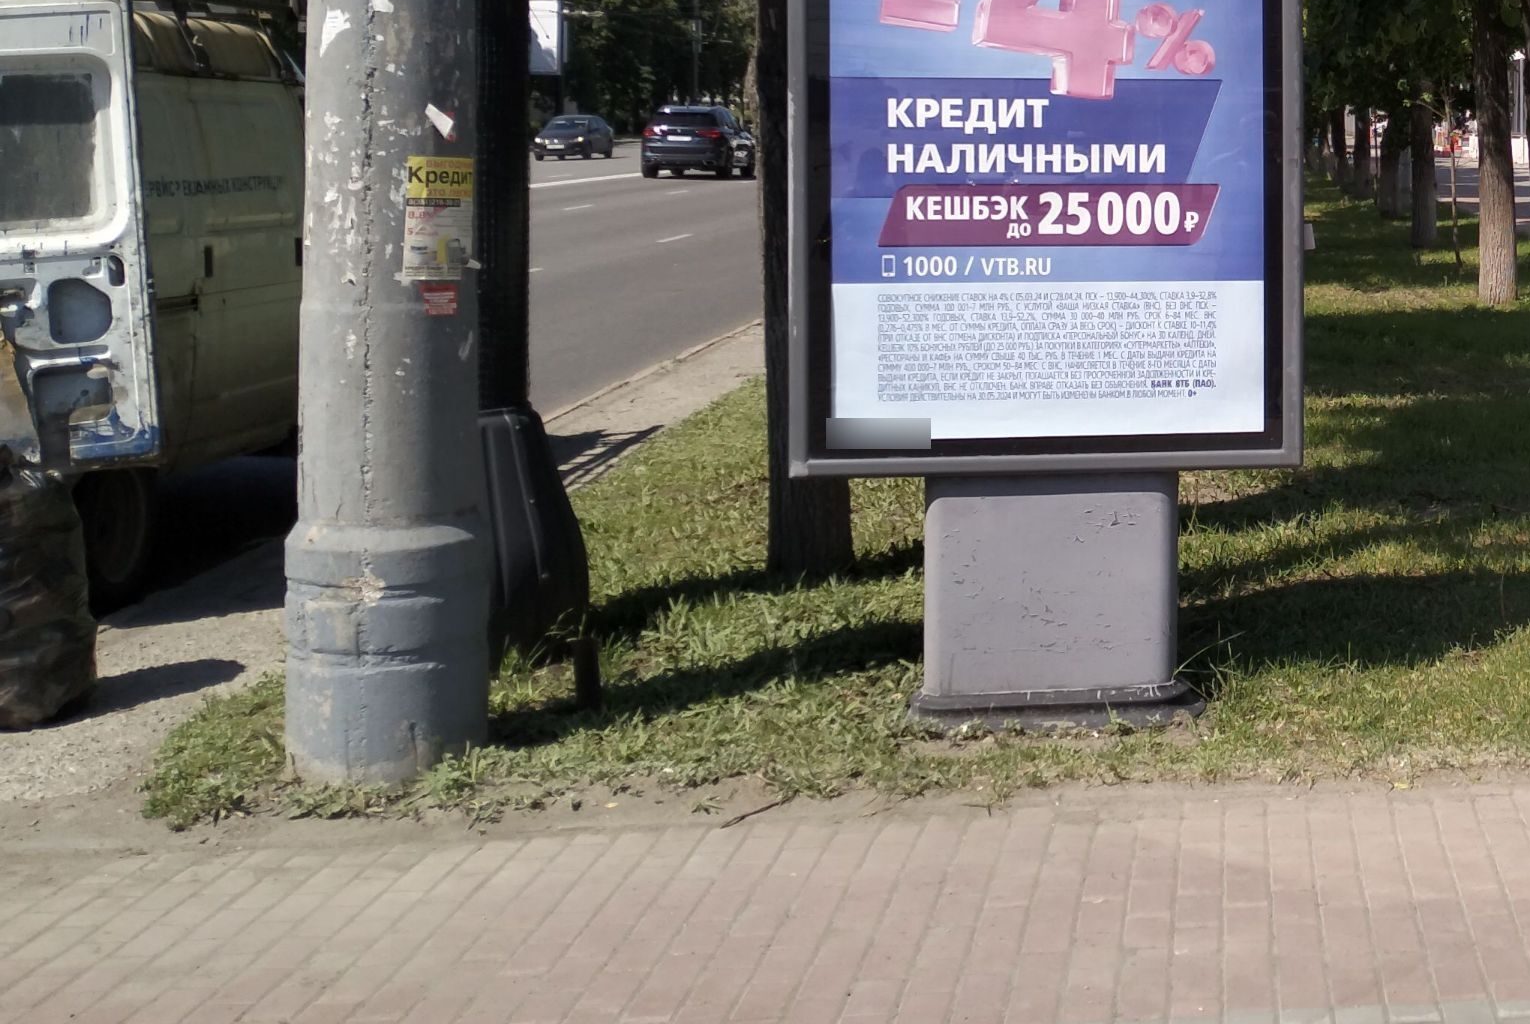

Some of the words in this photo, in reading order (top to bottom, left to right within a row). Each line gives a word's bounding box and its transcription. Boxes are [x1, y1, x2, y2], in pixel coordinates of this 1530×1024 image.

[887, 97, 1049, 134] КРЕДИТ
[887, 143, 1166, 174] НАЛИЧНЫМИ
[408, 166, 472, 188] Кредит
[906, 196, 1029, 221] КЕШБЭК
[903, 256, 957, 277] 1000
[980, 257, 1052, 277] VTB.RU
[924, 293, 960, 302] СНИЖЕНИЕ
[961, 293, 988, 302] СТАВОК
[1160, 290, 1184, 300] СТАВКА
[915, 303, 940, 312] СУММА
[979, 302, 994, 311] МЛН
[1024, 302, 1052, 311] УСЛУГОЙ
[1082, 301, 1109, 310] НИЗКАЯ
[970, 312, 996, 321] СТАВКА
[1041, 312, 1066, 321] СУММА
[1108, 311, 1124, 320] МЛН
[1144, 310, 1162, 320] СРОК
[1204, 310, 1217, 319] ВНС
[960, 322, 986, 331] СУММЫ
[1021, 322, 1046, 331] ОПЛАТА
[1048, 321, 1068, 331] СРАЗУ
[1079, 321, 1096, 330] ВЕСЬ
[1125, 321, 1156, 330] ДИСКОНТ
[1163, 320, 1187, 329] СТАВКЕ
[895, 333, 920, 342] ОТКАЗЕ
[949, 332, 976, 342] ОТМЕНА
[1024, 332, 1061, 341] ПОДПИСКА
[920, 343, 956, 352] БОНУСНЫХ
[958, 342, 982, 351] РУБЛЕЙ
[1045, 341, 1076, 350] ПОКУПКИ
[1082, 341, 1122, 350] КАТЕГОРИЯХ
[965, 352, 989, 361] СУММУ
[991, 352, 1015, 361] СВЫШЕ
[1068, 351, 1095, 360] ТЕЧЕНИЕ
[1127, 350, 1146, 359] ДАТЫ
[1147, 350, 1175, 359] ВЫДАЧИ
[1177, 350, 1206, 359] КРЕДИТА
[878, 363, 902, 372] СУММУ
[938, 362, 954, 371] МЛН
[973, 362, 1001, 371] СРОКОМ
[1065, 361, 1112, 370] НАЧИСЛЯЕТСЯ
[1120, 360, 1146, 369] ТЕЧЕНИЕ
[1164, 360, 1191, 369] МЕСЯЦА
[1198, 359, 1217, 369] ДАТЫ
[941, 372, 958, 381] ЕСЛИ
[960, 372, 984, 381] КРЕДИТ
[1026, 371, 1069, 380] ПОГАШАЕТСЯ
[1083, 370, 1136, 380] ПРОСРОЧЕННОЙ
[1137, 370, 1194, 379] ЗАДОЛЖЕННОСТИ
[943, 382, 956, 391] ВНС
[1009, 381, 1027, 391] БАНК
[1030, 381, 1054, 390] ВПРАВЕ
[1056, 381, 1089, 390] ОТКАЗАТЬ
[1151, 380, 1172, 389] БАНК
[1175, 380, 1190, 389] ВТБ
[1192, 379, 1217, 389] (ПАО).
[910, 392, 966, 401] ДЕЙСТВИТЕЛЬНЫ
[1019, 391, 1041, 400] МОГУТ
[1042, 391, 1060, 400] БЫТЬ
[1098, 390, 1128, 399] БАНКОМ
[1132, 390, 1156, 399] ЛЮБОЙ
